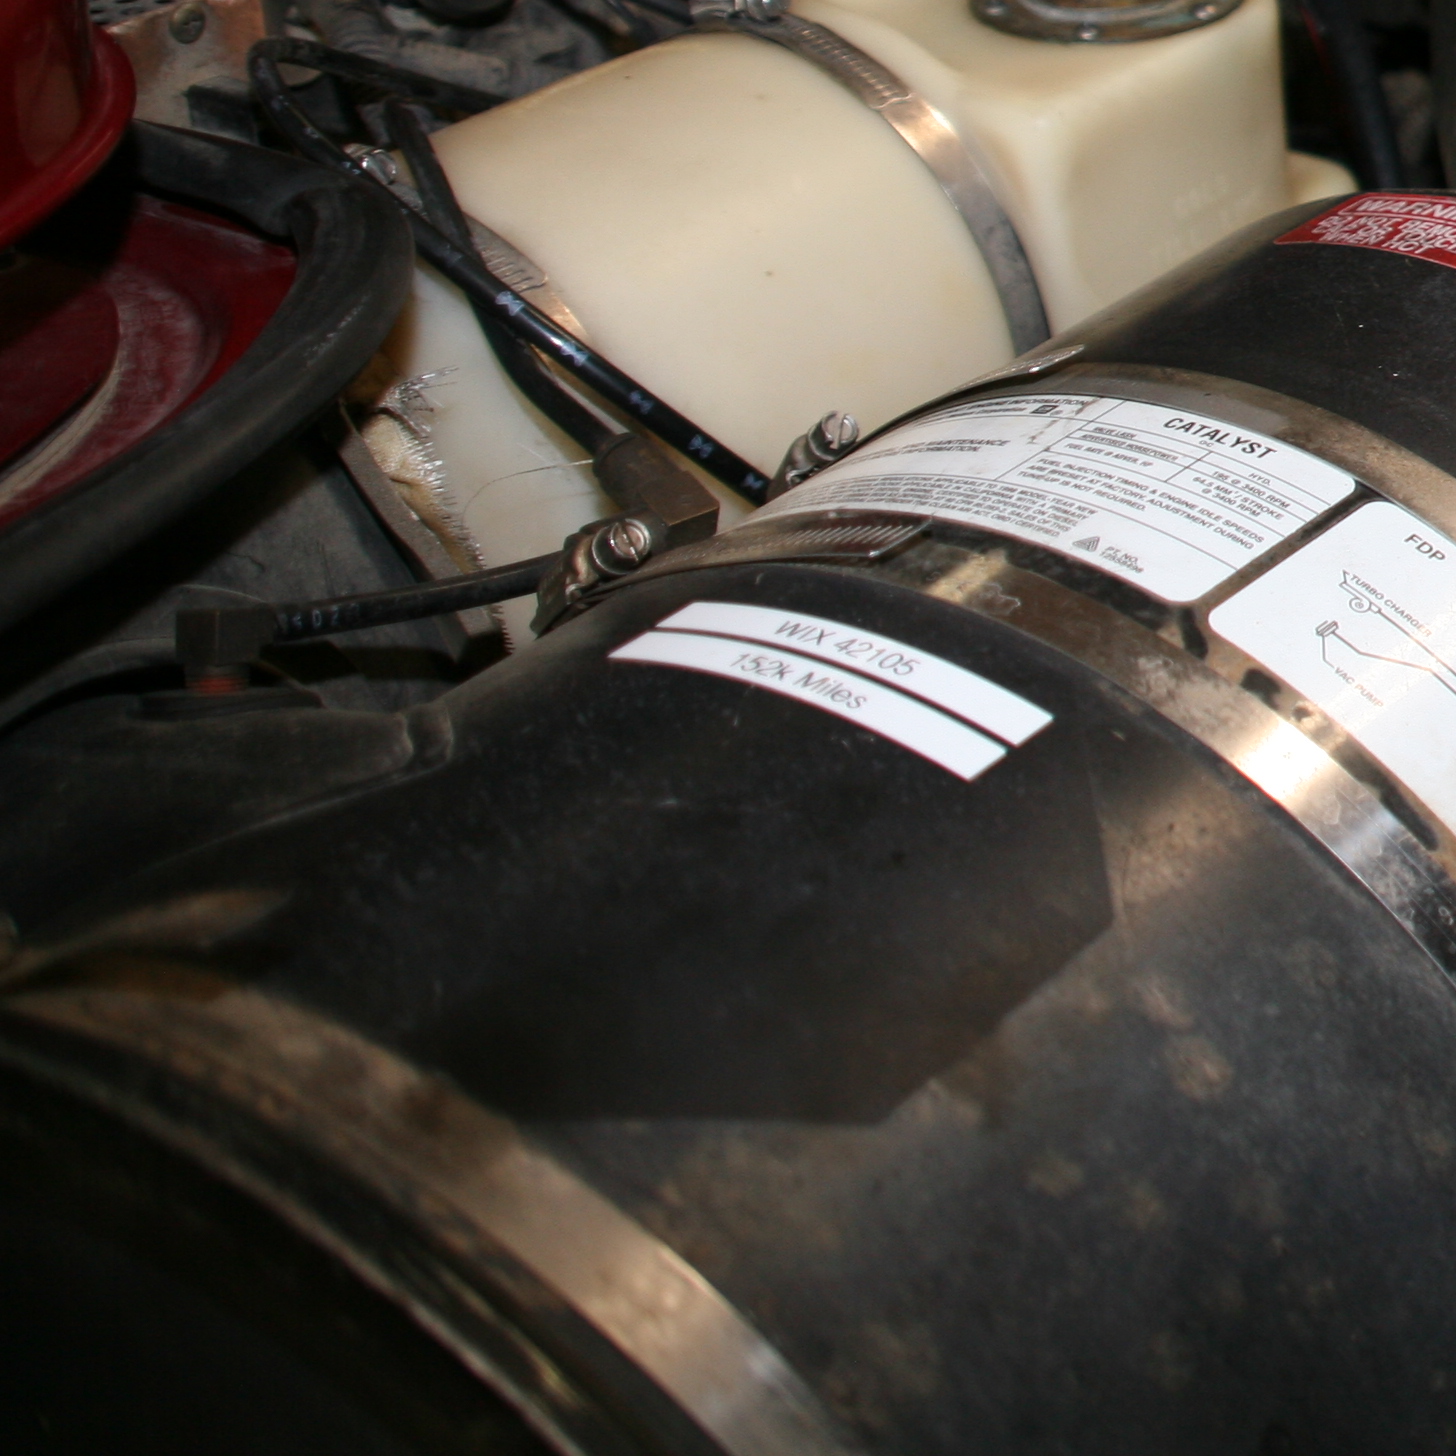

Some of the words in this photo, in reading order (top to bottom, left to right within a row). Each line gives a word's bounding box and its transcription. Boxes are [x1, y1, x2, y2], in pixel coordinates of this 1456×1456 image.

[1352, 216, 1404, 227] NOT
[1319, 232, 1386, 245] WHEN
[1381, 239, 1434, 255] HOT
[925, 439, 1011, 447] MAINTENANCE
[1084, 446, 1104, 454] RATE
[1125, 443, 1179, 461] HORSEPOWER
[1163, 418, 1278, 459] CATALYST
[961, 486, 1015, 500] CALIFORNIA
[1047, 504, 1090, 520] PRIMARY
[1037, 458, 1061, 467] FUEL
[1062, 463, 1116, 480] INJECTION
[1114, 476, 1149, 491] TIMING
[1158, 491, 1200, 511] ENGINE
[1198, 508, 1223, 522] IDLE
[1222, 519, 1265, 543] SPEEDS
[1070, 483, 1095, 492] NOT
[1192, 476, 1215, 488] 64.5
[1241, 496, 1284, 521] STROKE
[1201, 487, 1213, 495] @
[1212, 493, 1238, 506] 3400
[1235, 503, 1262, 518] RPM
[1212, 470, 1230, 481] 195
[1242, 483, 1267, 497] 3400
[1265, 494, 1291, 509] RPM
[991, 498, 1033, 512] OPERATE
[1032, 508, 1050, 516] ON
[1047, 513, 1079, 527] DIESEL
[1007, 509, 1039, 521] SALES
[1037, 517, 1052, 525] OF
[1050, 521, 1072, 532] THIS
[1027, 464, 1049, 472] ARE
[1085, 477, 1103, 485] AT
[1147, 498, 1214, 528] ADJUSTMENT
[1212, 526, 1255, 549] DURING
[1074, 505, 1099, 515] NEW
[1403, 533, 1446, 563] FDP
[1350, 574, 1385, 600] TURBO
[1384, 599, 1432, 637] CHARGER
[775, 619, 836, 648] WIX
[833, 636, 921, 678] 42105
[730, 651, 793, 682] 152k
[795, 671, 869, 711] Miles
[1334, 666, 1355, 685] VAC
[1354, 683, 1384, 708] PUMP
